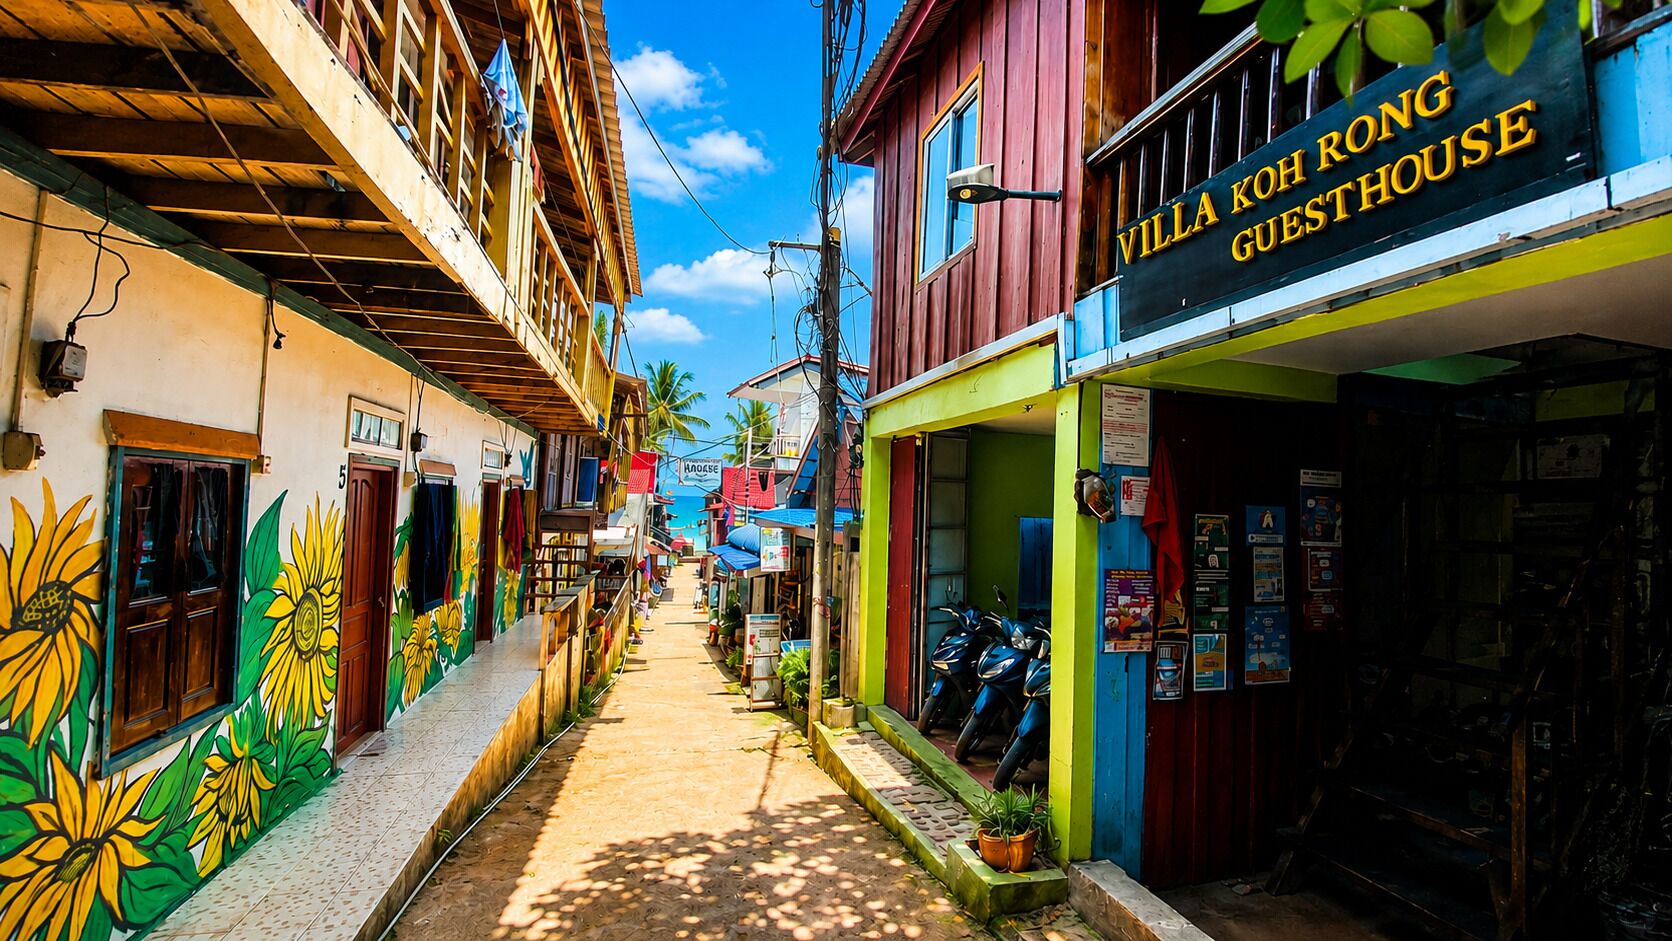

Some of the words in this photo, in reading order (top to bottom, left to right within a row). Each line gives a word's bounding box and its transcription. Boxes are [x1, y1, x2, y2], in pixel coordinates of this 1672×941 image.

[1116, 191, 1219, 265] VILLA
[1231, 149, 1307, 215] KOH
[1317, 70, 1455, 171] RONG
[1231, 99, 1538, 262] GUESTHOUSE
[338, 464, 346, 489] 5
